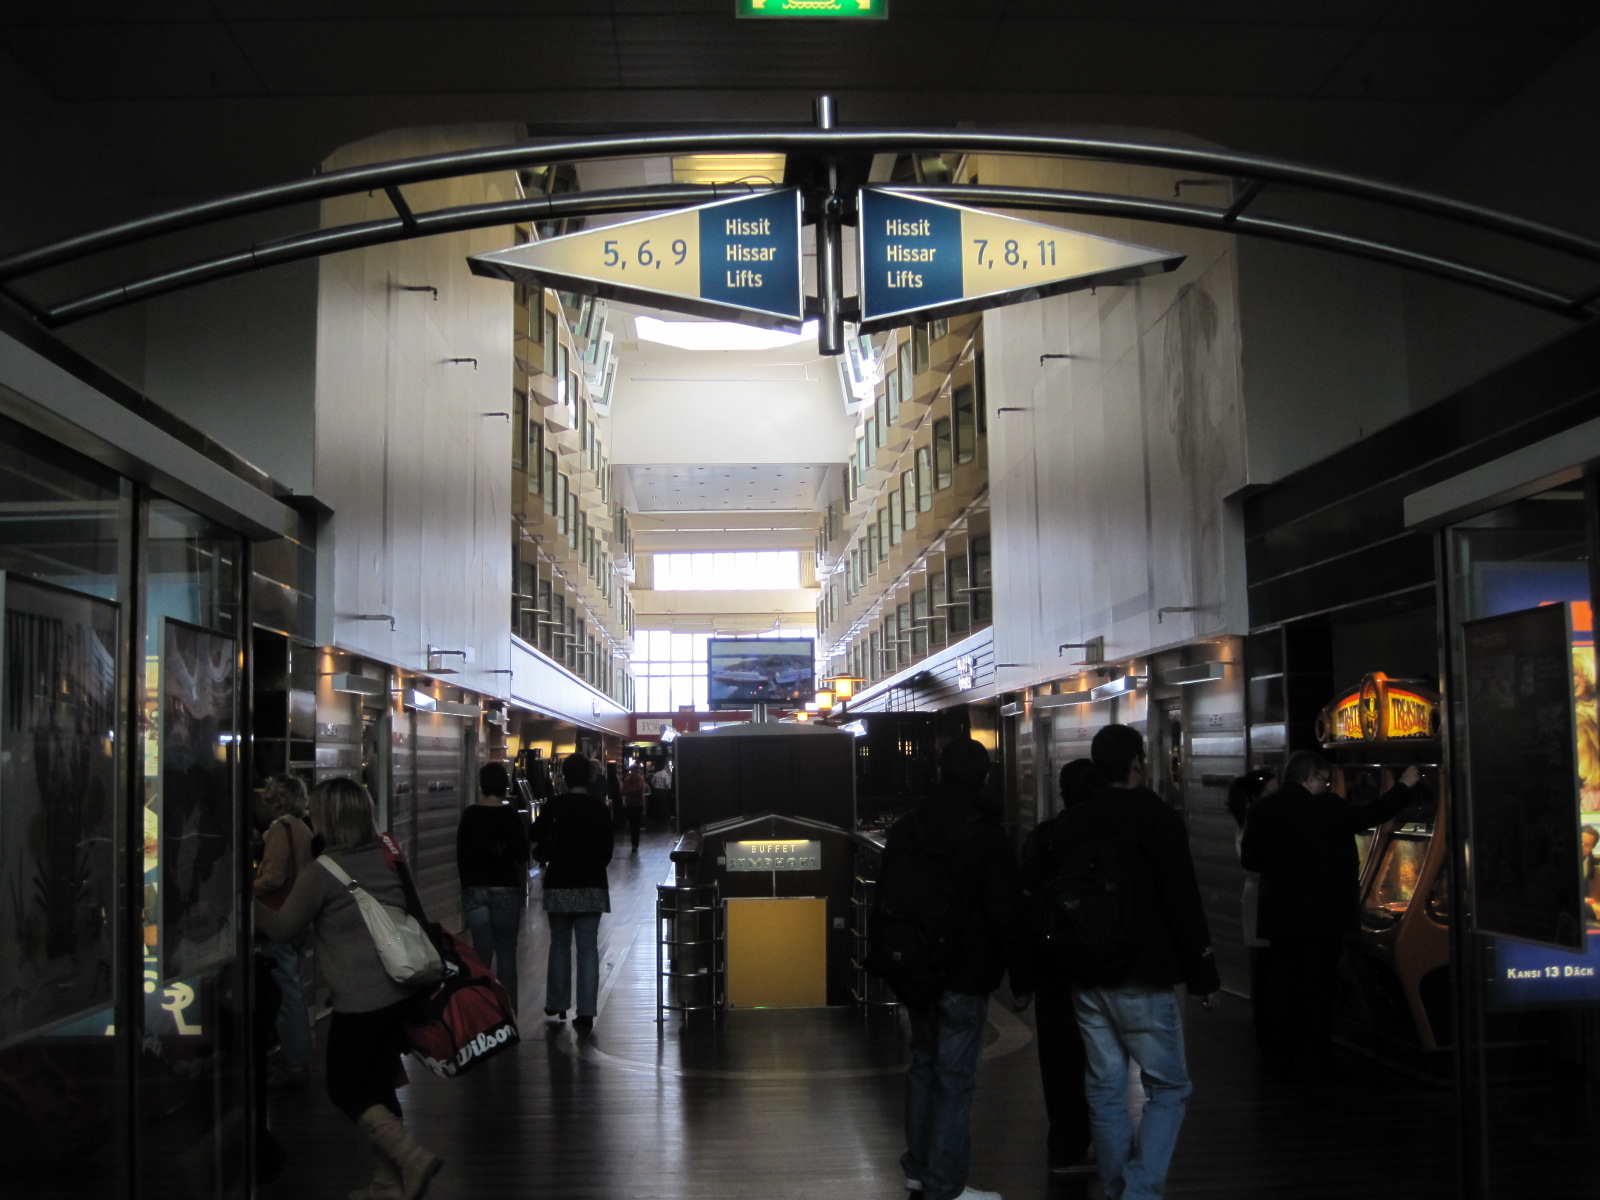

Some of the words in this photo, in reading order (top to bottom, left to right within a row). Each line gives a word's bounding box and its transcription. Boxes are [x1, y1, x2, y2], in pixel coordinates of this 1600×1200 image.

[726, 218, 771, 236] Hissit
[886, 219, 931, 237] Hissit
[726, 244, 776, 262] Hissar
[886, 245, 936, 263] Hissar
[726, 270, 763, 288] Lifts
[887, 271, 923, 288] Lifts
[1391, 697, 1428, 731] TREASURE
[751, 844, 796, 854] BUFFET
[1545, 966, 1560, 978] 13
[456, 1024, 517, 1068] Wilson
